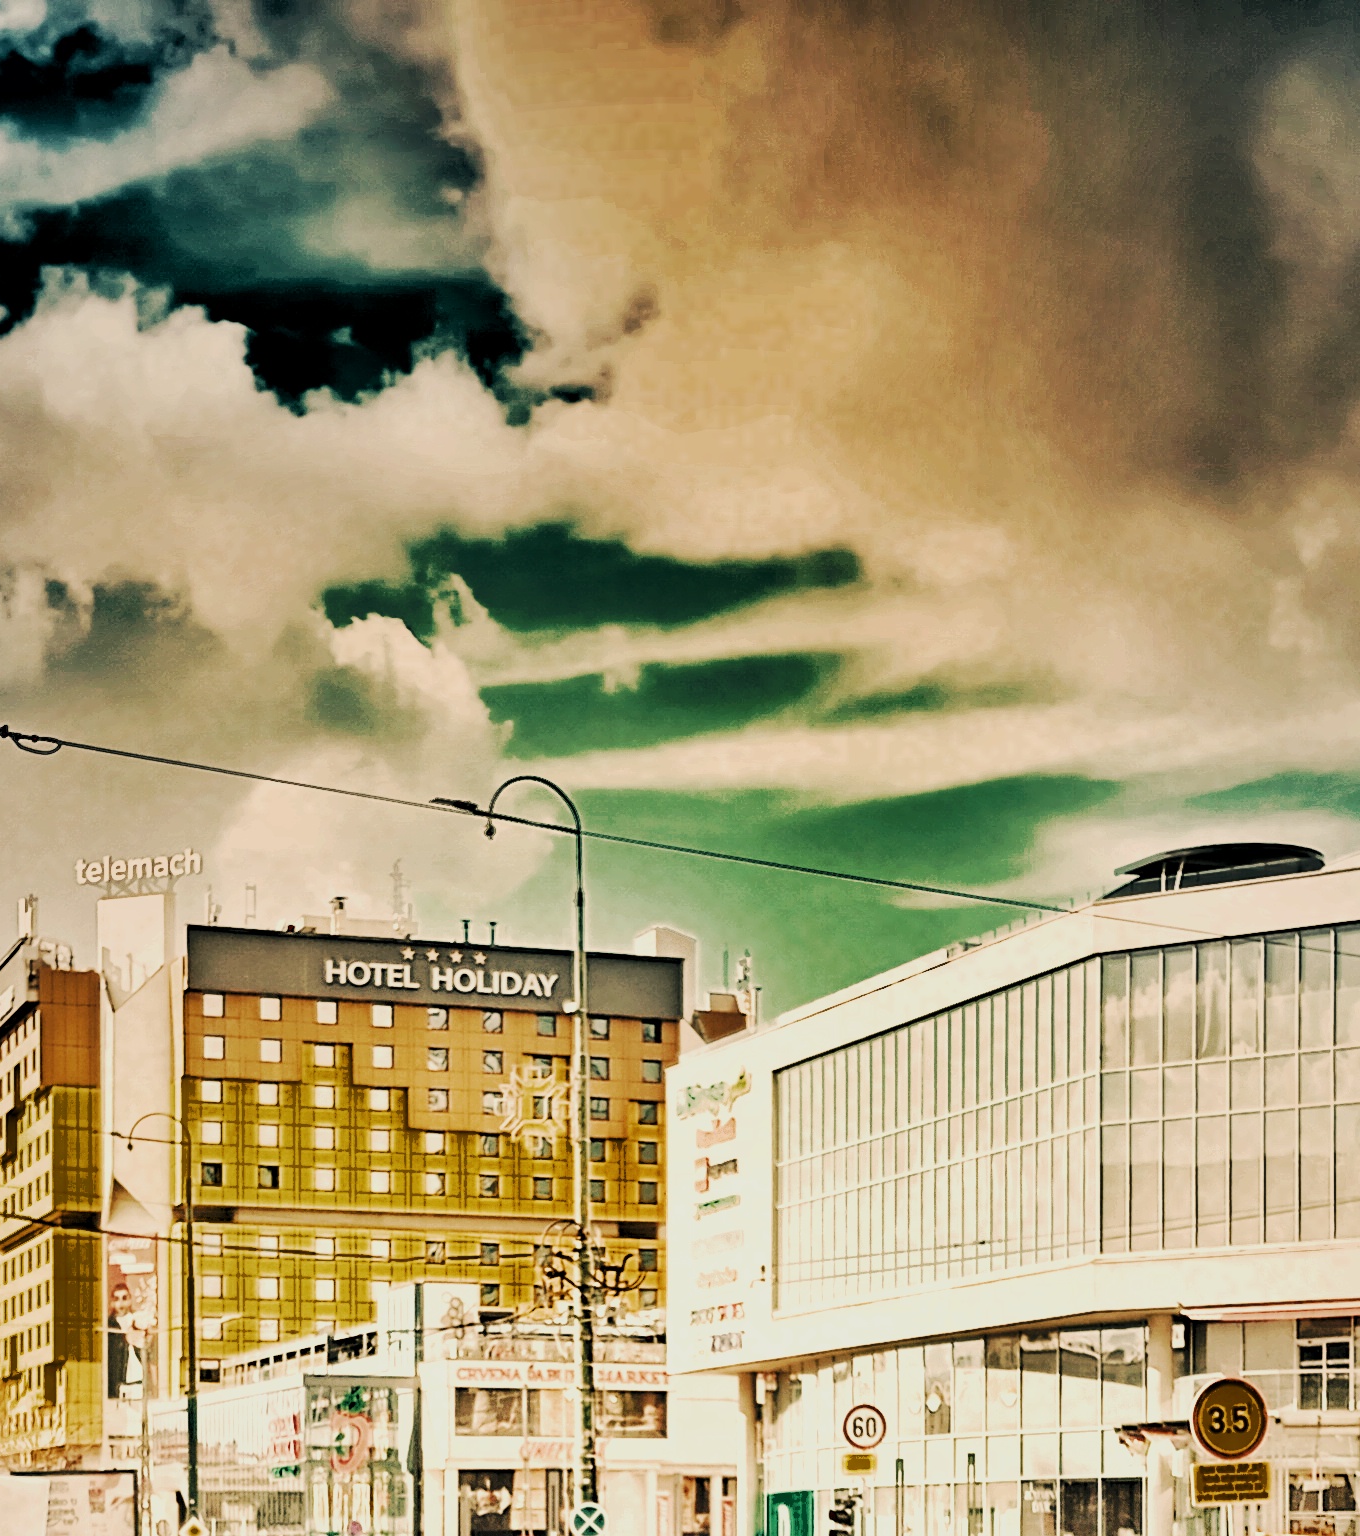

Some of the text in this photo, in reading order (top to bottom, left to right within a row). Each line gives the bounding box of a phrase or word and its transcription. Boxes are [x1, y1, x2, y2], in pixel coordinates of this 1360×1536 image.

[74, 848, 202, 884] telemach
[325, 959, 559, 998] HOTEL HOLIDAY
[456, 1367, 521, 1382] CRVENA
[597, 1370, 670, 1385] MARKET
[852, 1417, 877, 1438] 60
[1207, 1406, 1251, 1434] 3.5
